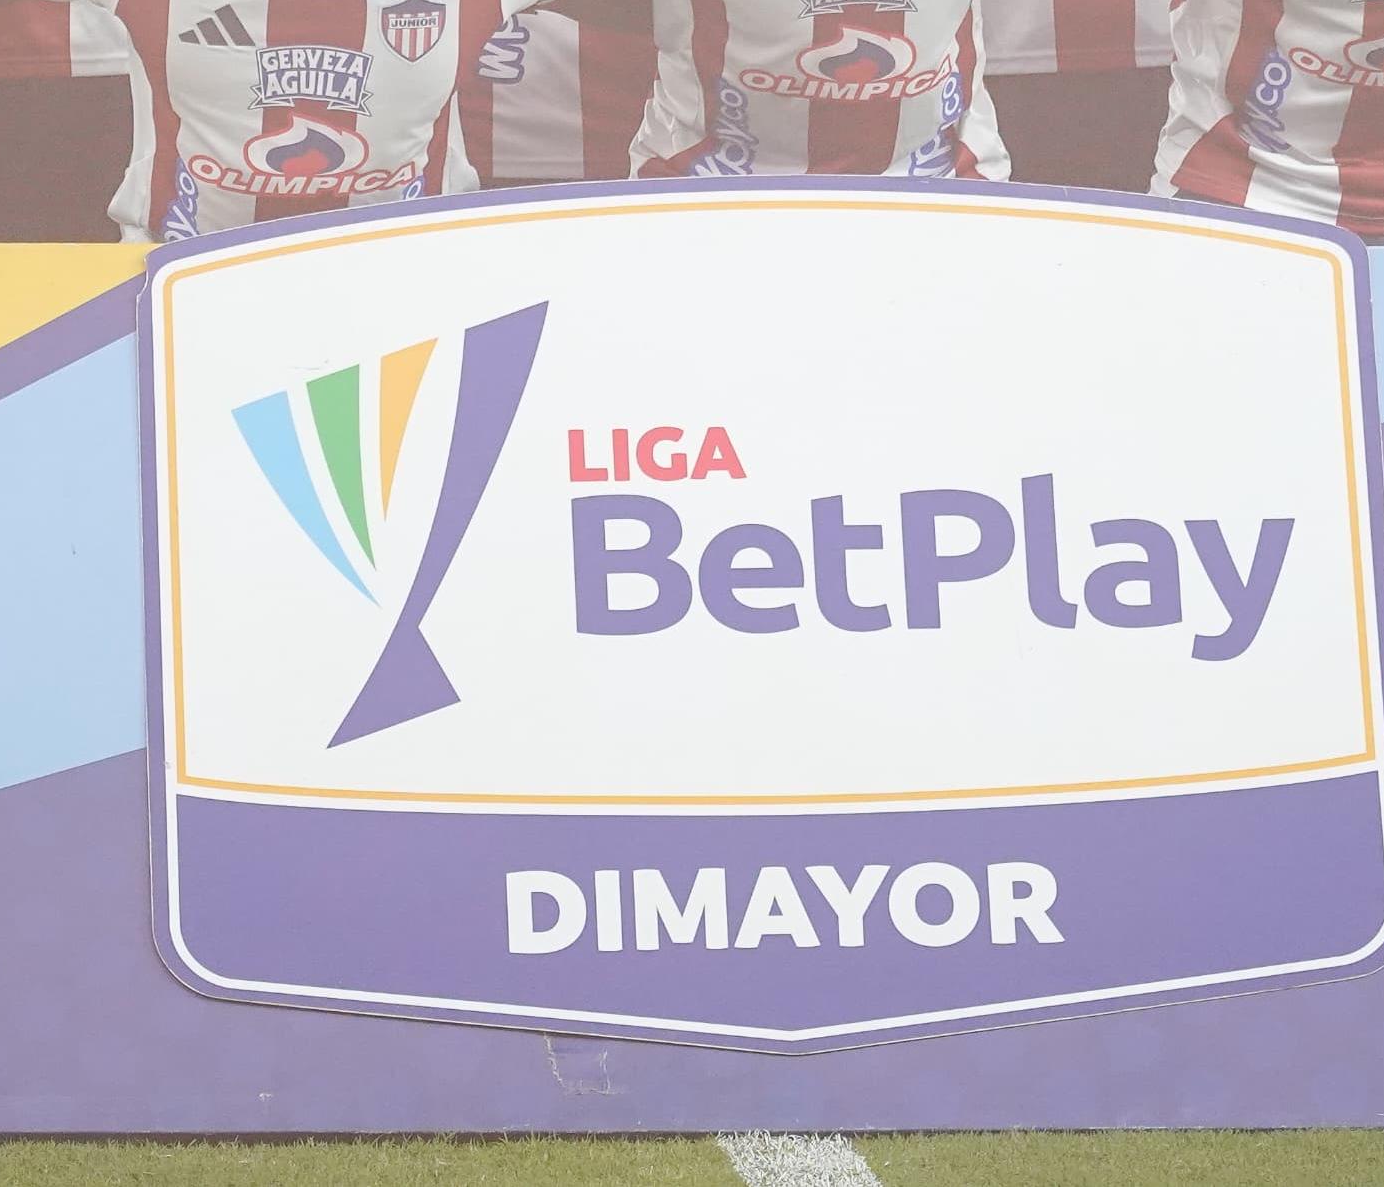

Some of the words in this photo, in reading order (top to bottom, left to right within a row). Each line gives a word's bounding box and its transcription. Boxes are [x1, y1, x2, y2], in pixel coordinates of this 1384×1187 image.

[390, 17, 437, 29] JUNIOR
[266, 70, 358, 103] AGUILA
[189, 161, 416, 196] OLIMPICA
[567, 426, 748, 483] LIGA
[569, 472, 1297, 661] BetPlay
[504, 861, 1066, 955] DIMAYOR
